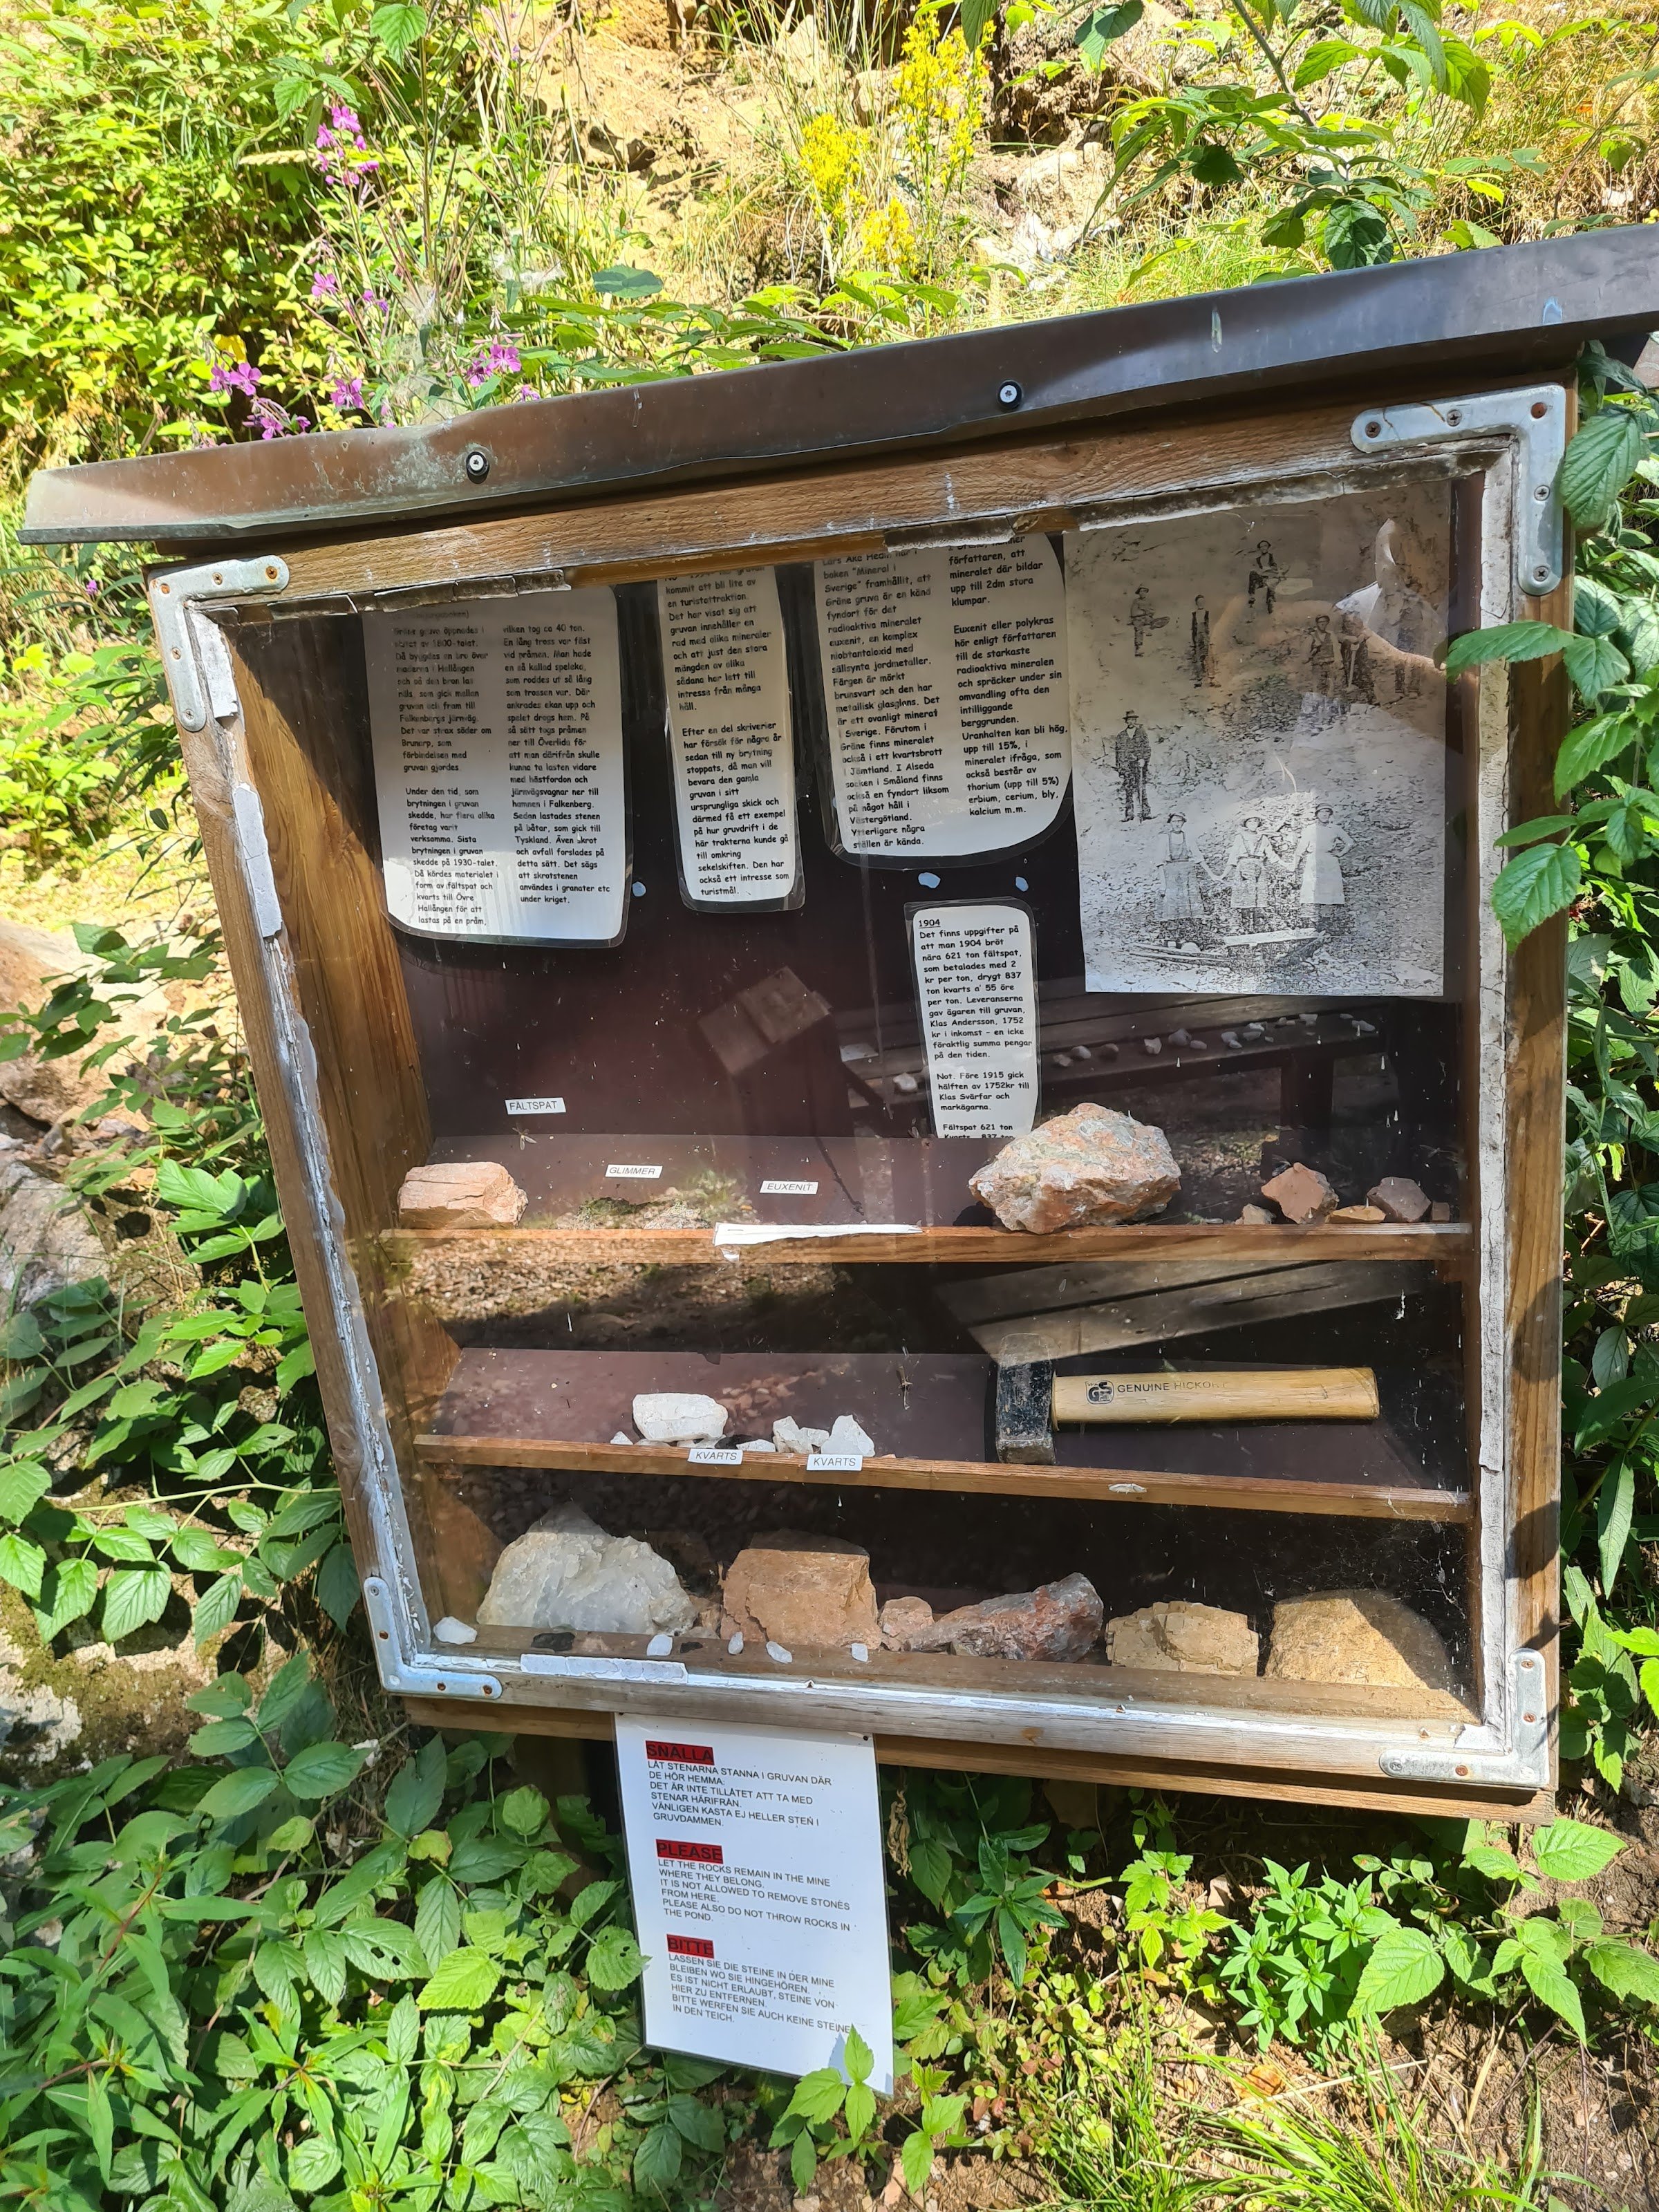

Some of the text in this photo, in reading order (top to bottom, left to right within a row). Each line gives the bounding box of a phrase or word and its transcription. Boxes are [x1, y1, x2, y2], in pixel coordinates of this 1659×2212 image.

[950, 578, 1033, 594] upp till 2dm stora
[955, 631, 1056, 647] hör enligt författaren
[955, 647, 1030, 661] till de starkaste
[963, 747, 979, 755] upp
[982, 742, 994, 751] till
[998, 740, 1020, 750] 15%,
[689, 791, 715, 800] gruvan
[549, 800, 594, 809] Falkenberg.
[691, 797, 779, 812] ursprungliga skick och
[692, 814, 722, 823] därmed
[725, 812, 735, 821] få
[754, 809, 785, 819] exempel
[969, 807, 1001, 816] kalcium
[411, 847, 451, 856] brytningen
[696, 850, 741, 859] till omkring
[413, 857, 498, 868] skedde på 1930-talet.
[698, 862, 748, 872] sekelskiften.
[753, 861, 768, 869] Den
[701, 885, 739, 895] turistmål.
[544, 895, 570, 905] kriget.
[919, 919, 940, 928] 1904
[964, 927, 1005, 937] uppgifter
[1009, 925, 1019, 935] på
[959, 939, 982, 948] 1904
[983, 950, 1022, 958] fältspat,
[944, 962, 986, 971] betalades
[930, 1019, 948, 1027] Klas
[1007, 1071, 1024, 1080] gick
[509, 1100, 558, 1112] FÄLTSPAT
[610, 1166, 656, 1176] GLIMMER
[767, 1182, 813, 1192] EUXENIT
[1117, 1382, 1170, 1393] GENUINE
[695, 1451, 738, 1461] KVARTS
[814, 1457, 856, 1467] KVARTS
[646, 1743, 714, 1763] SNÄLLA
[648, 1761, 664, 1770] LÅT
[668, 1762, 719, 1774] STENARNA
[720, 1768, 760, 1779] STANNA
[767, 1772, 808, 1783] GRUVAN
[811, 1777, 832, 1785] DÄR
[650, 1781, 813, 1804] DET ÄR INTE TILLÅTET ATT TA MED
[651, 1792, 742, 1808] STENAR HÄRIFRÅN.
[652, 1802, 699, 1813] VÄNLIGEN
[702, 1807, 733, 1817] KASTA
[735, 1810, 746, 1819] EJ
[749, 1812, 785, 1822] HELLER
[788, 1816, 814, 1826] STEN
[653, 1812, 724, 1826] GRUVDAMMEN.
[657, 1842, 722, 1861] PLEASE
[658, 1859, 674, 1867] LET
[679, 1861, 696, 1870] THE
[699, 1864, 731, 1874] ROCKS
[734, 1868, 770, 1879] REMAIN
[787, 1874, 804, 1883] THE
[807, 1877, 830, 1887] MINE
[659, 1869, 764, 1888] WHERE THEY BELONG.
[662, 1888, 719, 1902] FROM HERE.
[663, 1898, 850, 1931] PLEASE ALSO DO NOT THROW ROCKS IN
[664, 1908, 713, 1921] THE POND.
[668, 1939, 713, 1956] BITTE
[668, 1953, 834, 1988] LASSEN SIE DIE STEINE IN DER MINE
[670, 1963, 809, 1994] BLEIBEN WO SIE HINGEHÖREN.
[671, 1983, 767, 2007] HIER ZU ENTFERNEN.
[672, 1994, 697, 2005] BITTE
[700, 1998, 738, 2013] WERFEN
[741, 2006, 756, 2016] SIE
[758, 2009, 784, 2021] AUCH
[787, 2014, 814, 2027] KEINE
[673, 2004, 734, 2023] IN DEN TEICH.
